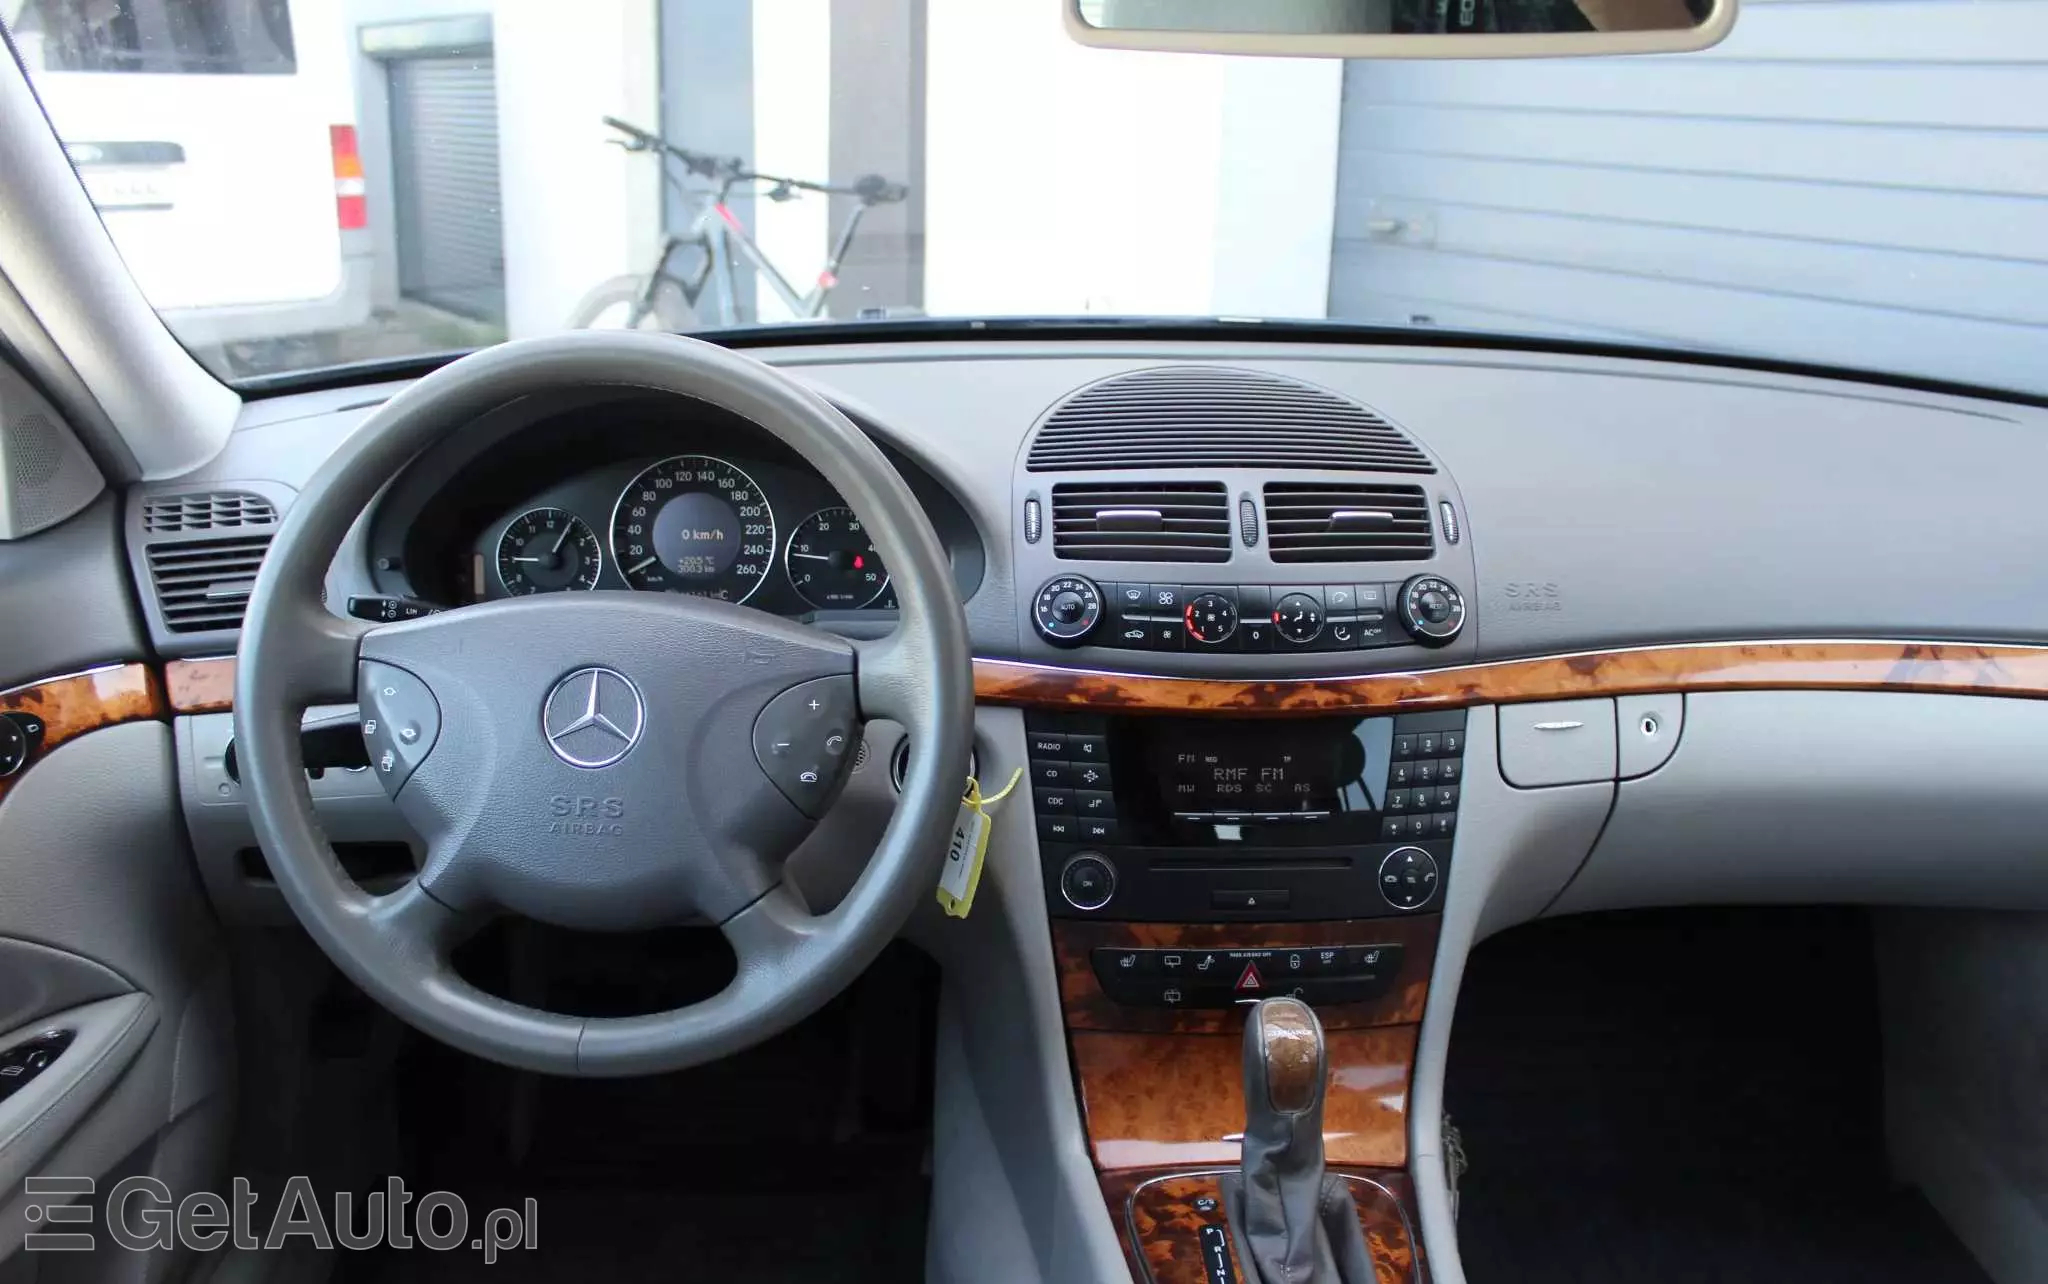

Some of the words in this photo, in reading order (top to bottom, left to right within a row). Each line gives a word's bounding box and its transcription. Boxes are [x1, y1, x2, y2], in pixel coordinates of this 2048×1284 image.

[674, 472, 692, 481] 120
[698, 471, 715, 481] 140
[655, 479, 673, 489] 100
[718, 479, 735, 489] 160
[642, 491, 657, 501] 80
[731, 491, 749, 501] 180
[632, 507, 646, 517] 60
[740, 506, 761, 517] 200
[546, 520, 554, 528] 12
[819, 523, 829, 531] 20
[849, 523, 860, 531] 30
[627, 525, 642, 535] 40
[745, 525, 765, 535] 220
[681, 529, 690, 540] 0
[693, 529, 724, 541] km/h
[630, 545, 643, 555] 20
[743, 545, 764, 555] 240
[800, 544, 809, 552] 10
[867, 544, 876, 552] 4
[585, 556, 590, 565] 3
[736, 564, 757, 575] 260
[579, 574, 585, 582] 4
[804, 574, 811, 582] 0
[865, 573, 877, 581] 50
[1418, 583, 1427, 591] 20
[1207, 600, 1214, 608] 3
[1194, 610, 1200, 618] 2
[1200, 625, 1205, 633] 1
[1217, 624, 1224, 633] 5
[1037, 741, 1061, 751] RADIO
[1426, 739, 1431, 747] 2
[1449, 738, 1455, 746] 3
[1178, 753, 1196, 763] FM
[1045, 770, 1058, 778] CD
[1214, 767, 1248, 781] RMF
[1261, 767, 1285, 781] FM
[1400, 768, 1404, 776] 4
[1423, 767, 1428, 775] 5
[1216, 783, 1243, 793] RDS
[1255, 783, 1273, 793] SC
[1047, 797, 1064, 806] CDC
[550, 795, 624, 818] SRS
[548, 821, 624, 837] AIRBAG
[950, 826, 965, 862] 410
[1320, 951, 1335, 960] ESP
